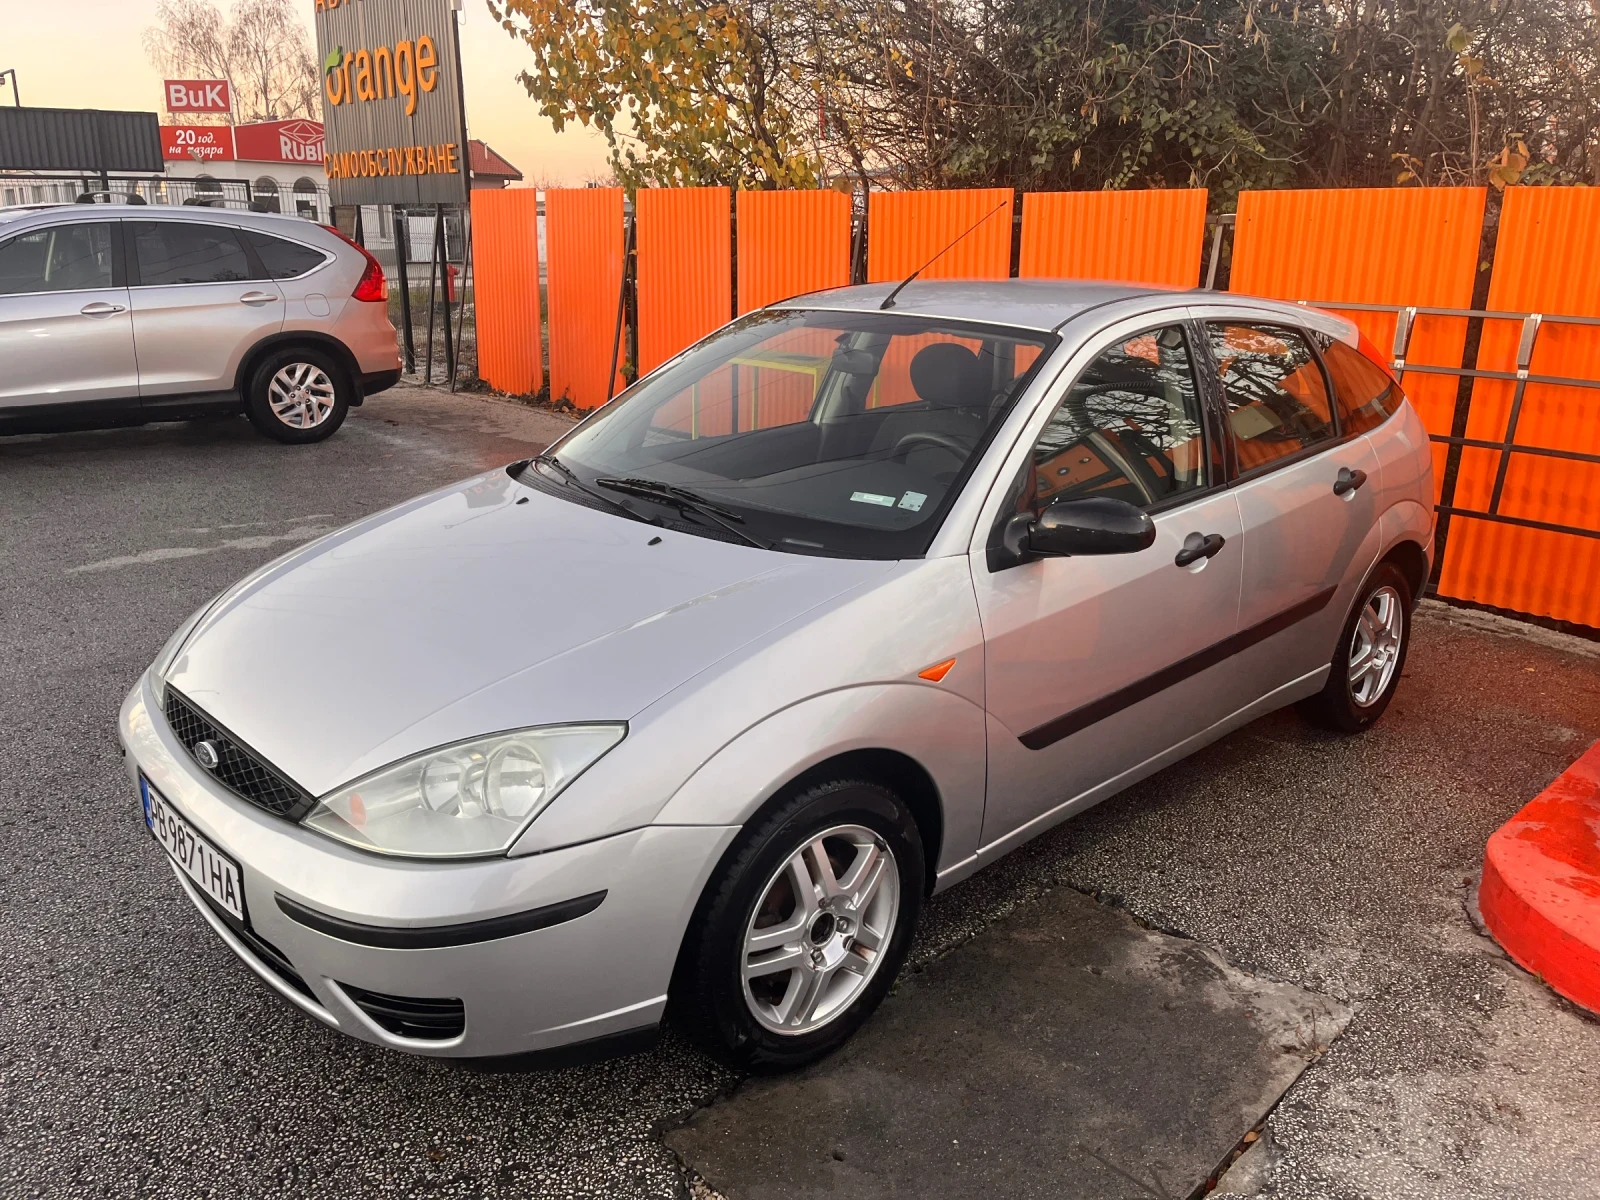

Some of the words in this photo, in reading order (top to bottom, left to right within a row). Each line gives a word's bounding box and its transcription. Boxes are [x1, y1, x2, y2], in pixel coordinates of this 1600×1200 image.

[325, 35, 439, 116] orange
[168, 145, 182, 154] на
[175, 129, 196, 145] 20
[323, 143, 459, 179] САМООБСЛУЖВАНЕ
